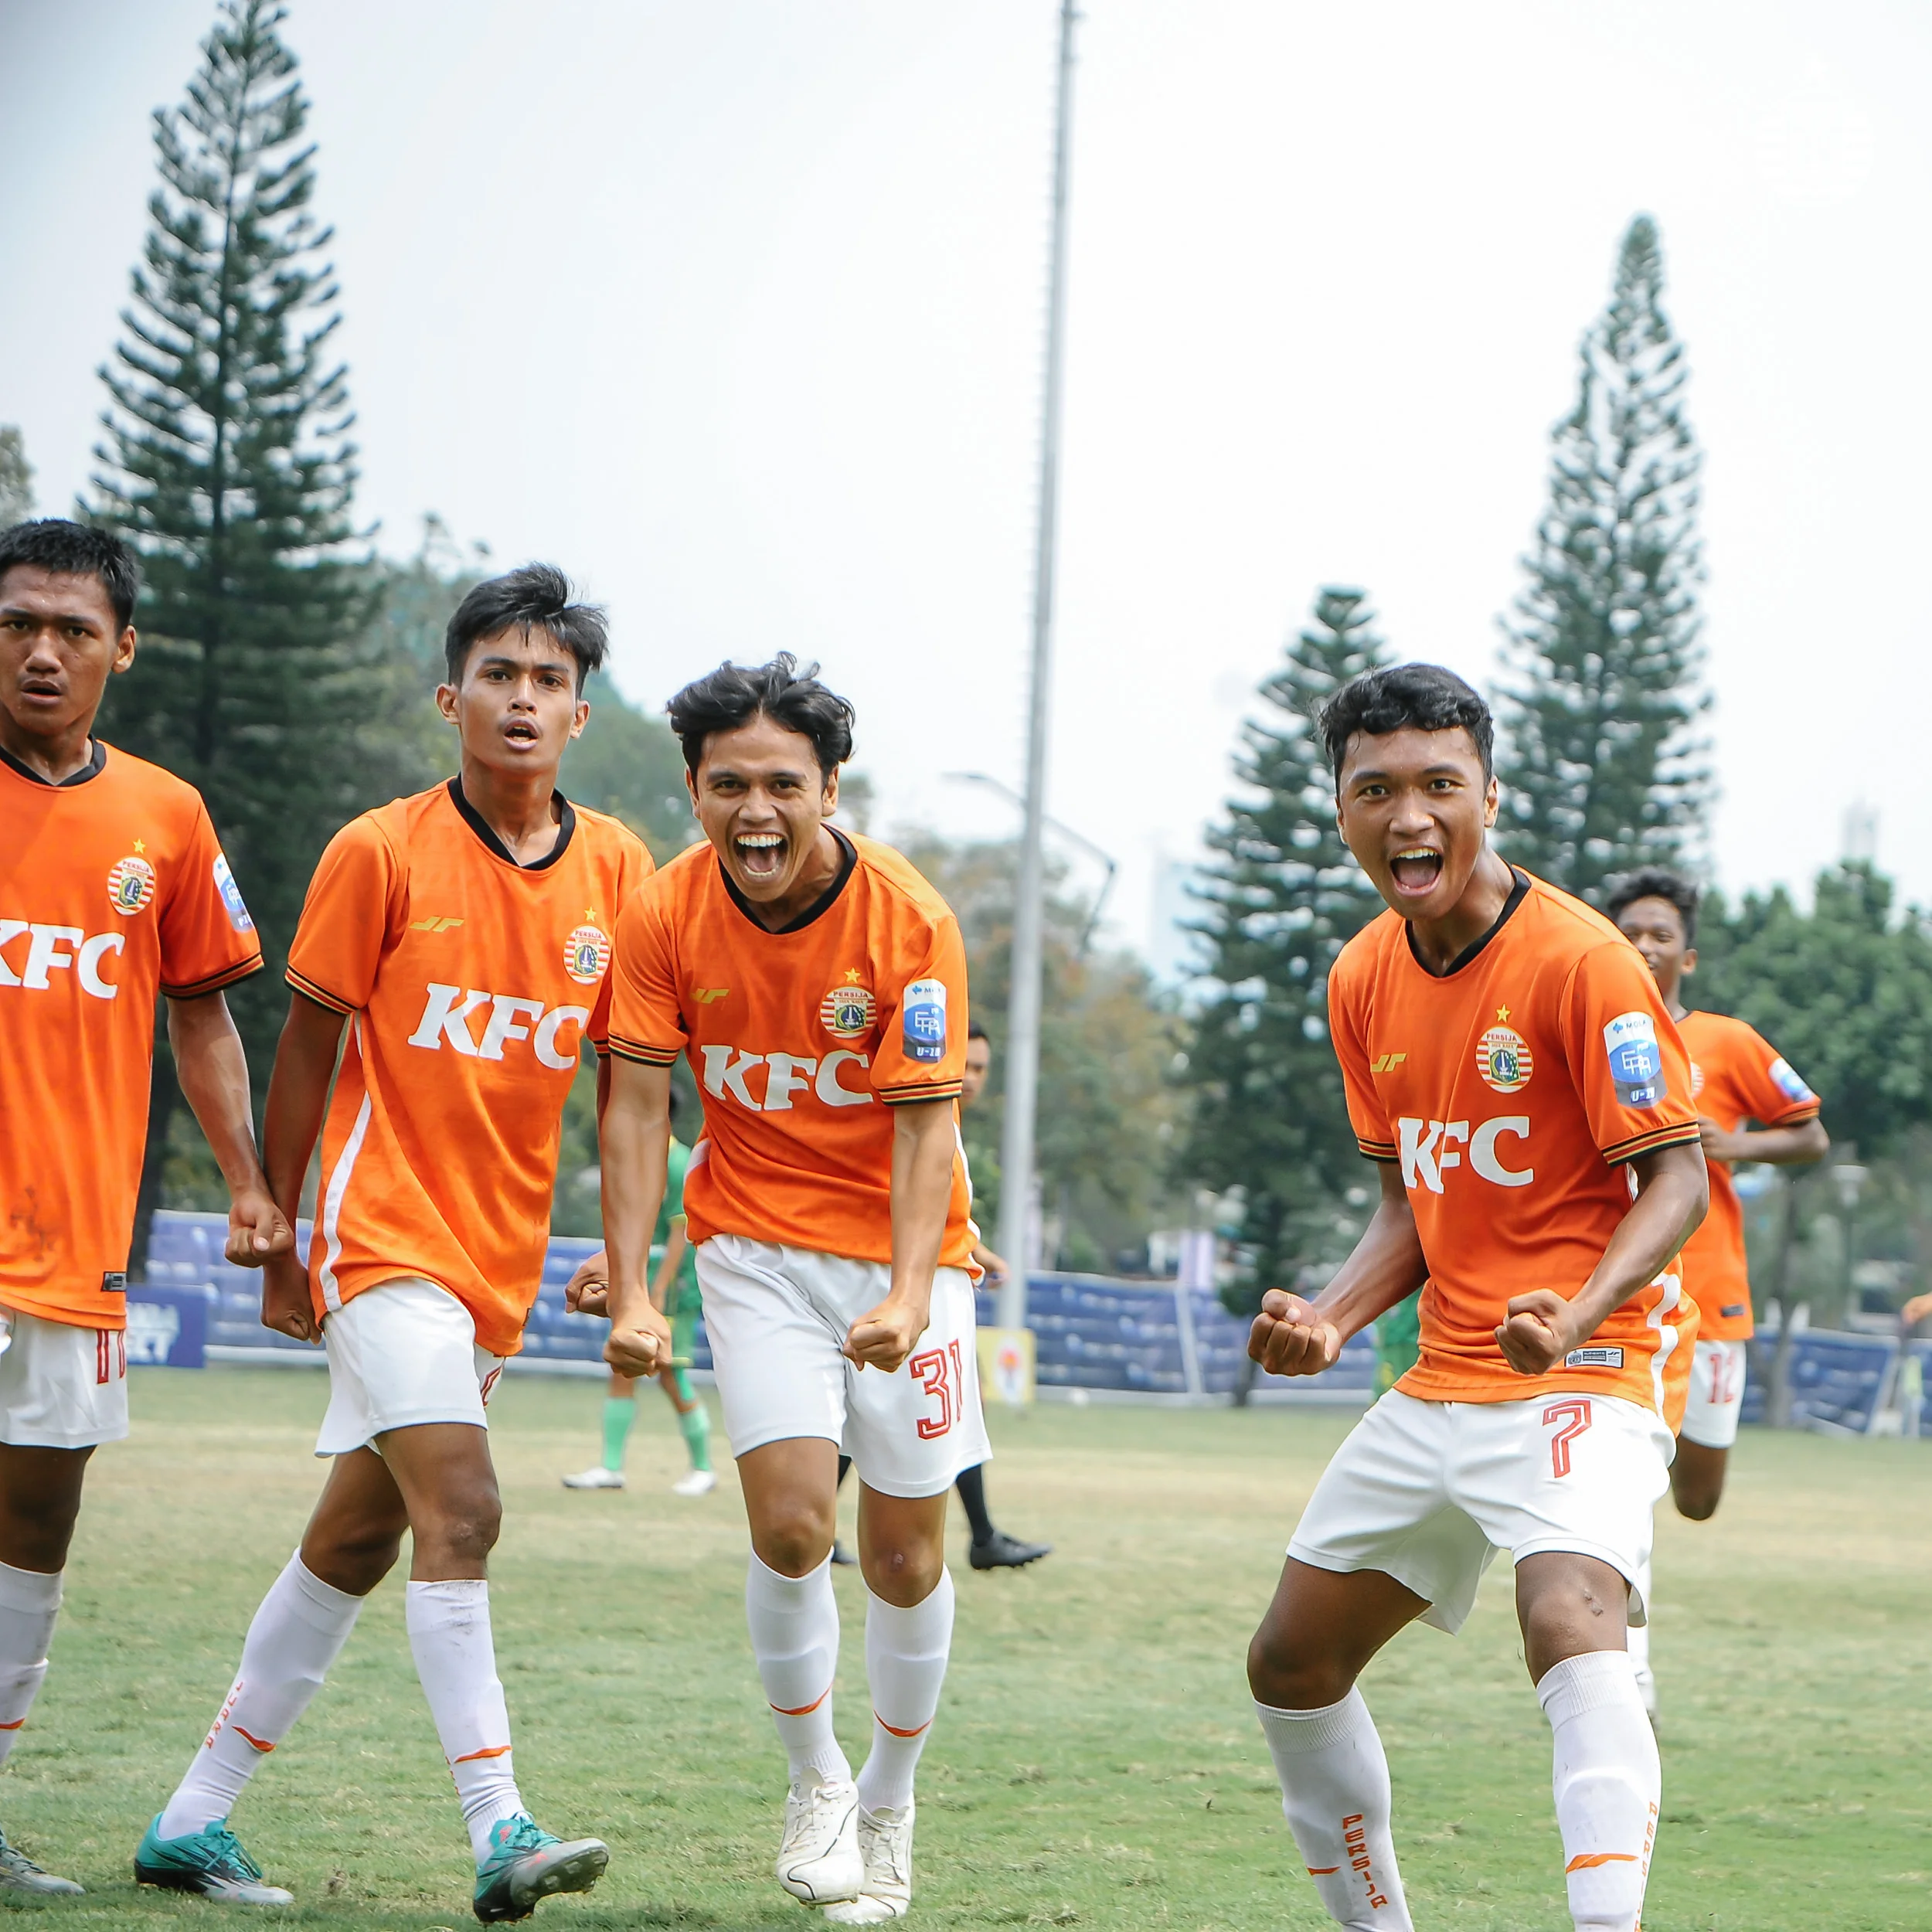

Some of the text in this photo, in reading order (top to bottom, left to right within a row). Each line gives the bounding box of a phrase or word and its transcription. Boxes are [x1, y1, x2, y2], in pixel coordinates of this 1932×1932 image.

[407, 982, 590, 1070] KFC
[1487, 1032, 1518, 1042] PERSIJA
[701, 1045, 873, 1111] KFC
[1398, 1115, 1534, 1194] KFC
[908, 1338, 963, 1440] 31
[1543, 1400, 1592, 1478] 7
[1342, 1814, 1388, 1910] PERSIJA
[1634, 1801, 1658, 1932] PERSIJA
